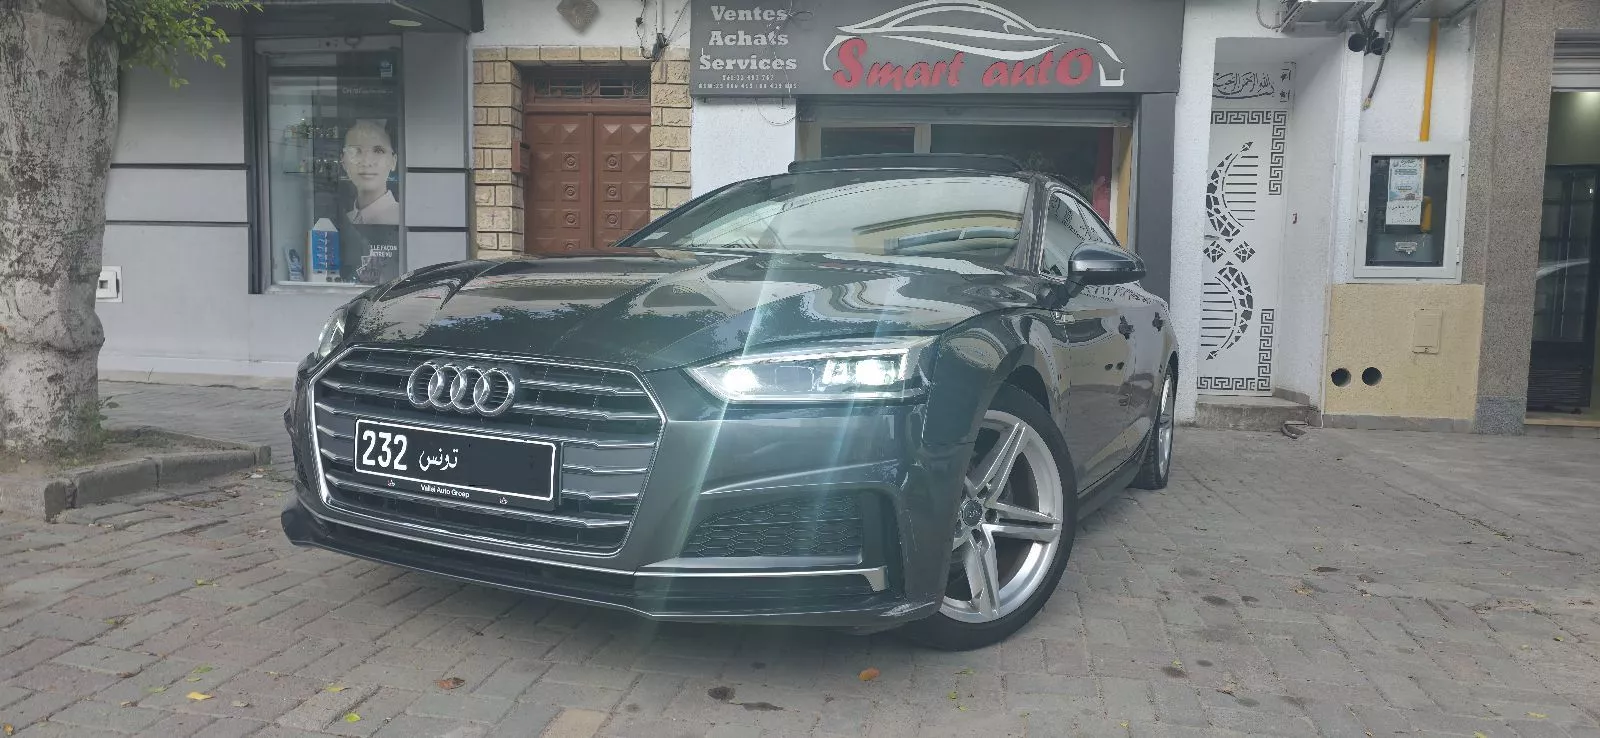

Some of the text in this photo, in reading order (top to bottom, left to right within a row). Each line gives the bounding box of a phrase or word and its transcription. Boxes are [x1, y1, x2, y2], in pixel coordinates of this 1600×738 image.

[711, 5, 788, 21] Ventes
[709, 30, 789, 46] Achats
[699, 54, 797, 70] Services
[833, 37, 965, 91] Smart
[362, 429, 408, 471] 232
[419, 447, 459, 472] تونس
[436, 487, 451, 495] Auto
